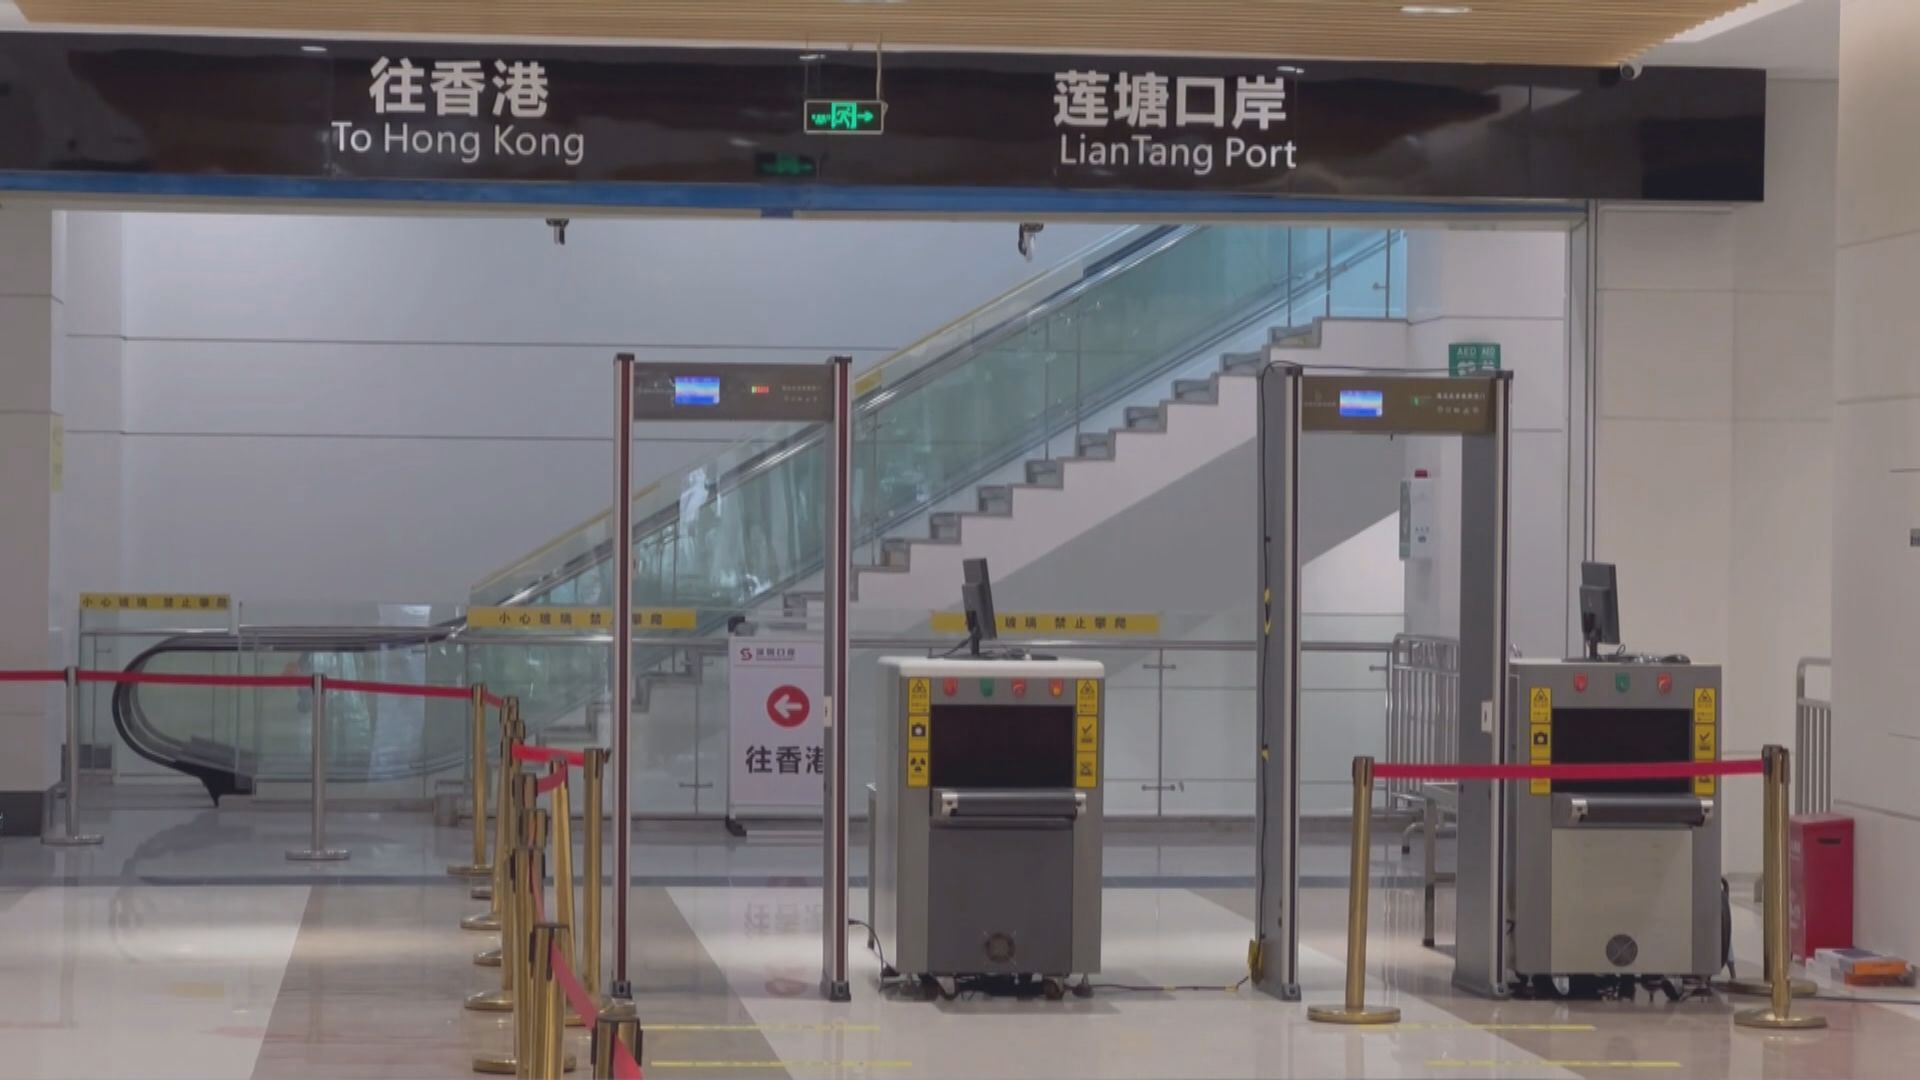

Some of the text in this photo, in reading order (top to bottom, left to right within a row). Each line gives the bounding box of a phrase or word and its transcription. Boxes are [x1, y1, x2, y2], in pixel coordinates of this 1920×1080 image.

[369, 56, 549, 118] 往香港
[1053, 70, 1287, 130] 莲塘口岸
[331, 121, 584, 165] To Hong Kong
[1060, 133, 1297, 175] LianTang Port
